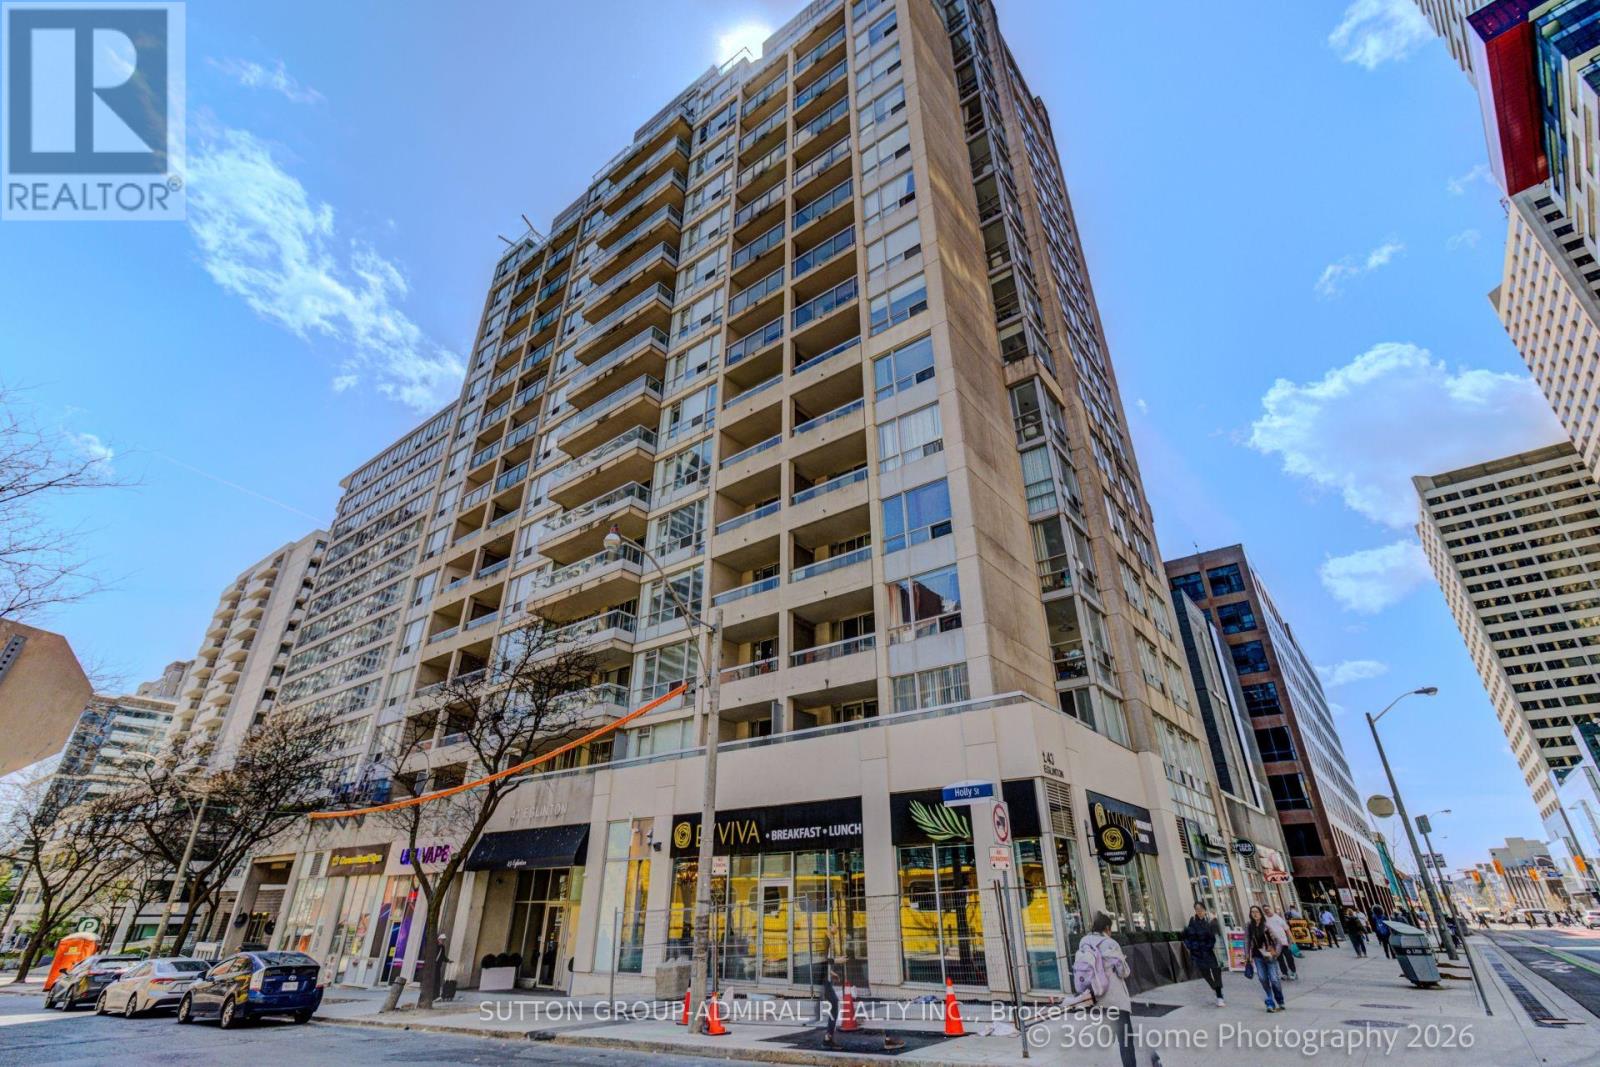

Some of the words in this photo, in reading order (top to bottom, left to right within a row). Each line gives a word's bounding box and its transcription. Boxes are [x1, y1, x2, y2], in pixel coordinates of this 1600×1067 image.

[954, 787, 972, 798] Holly
[973, 787, 980, 796] St
[695, 819, 761, 848] EVIVA
[771, 826, 821, 841] BREAKFAST
[828, 823, 862, 837] LUNCH
[422, 844, 450, 864] VAPE
